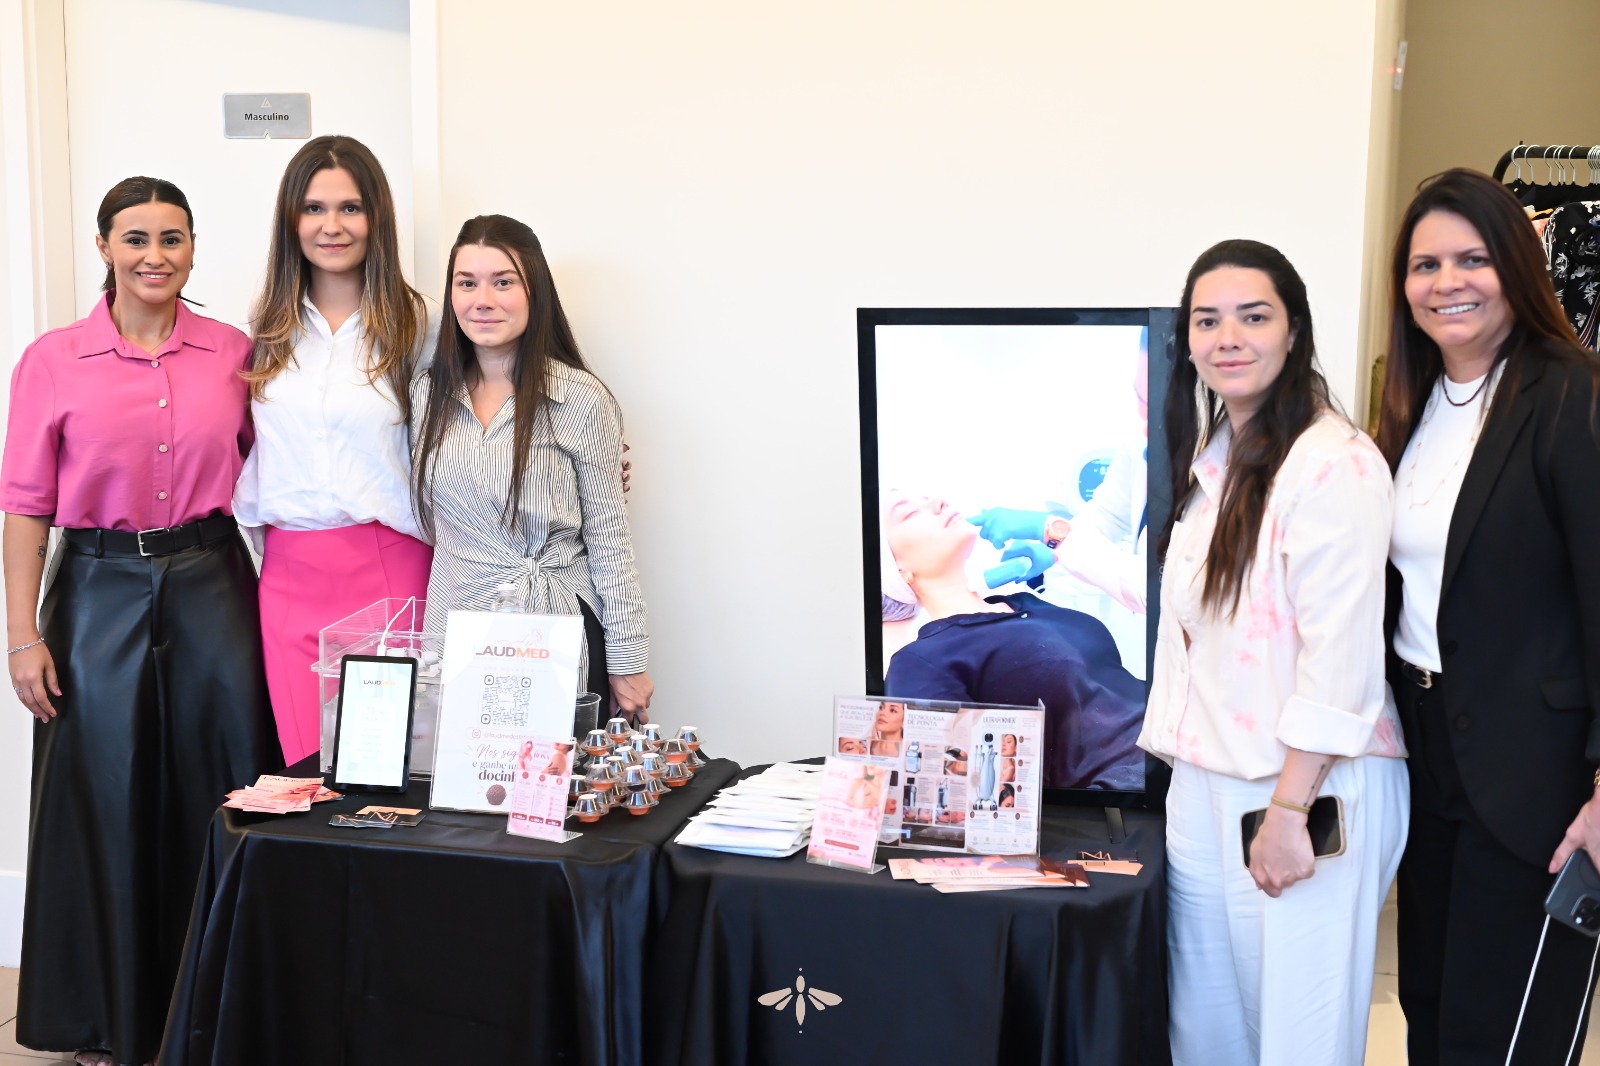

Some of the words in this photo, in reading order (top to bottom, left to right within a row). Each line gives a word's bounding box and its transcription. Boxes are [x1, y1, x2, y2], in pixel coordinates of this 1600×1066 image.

[244, 112, 290, 121] Masculino
[477, 743, 500, 759] Nos
[502, 747, 518, 762] sig
[479, 760, 507, 770] ganhe
[478, 769, 515, 782] docin
